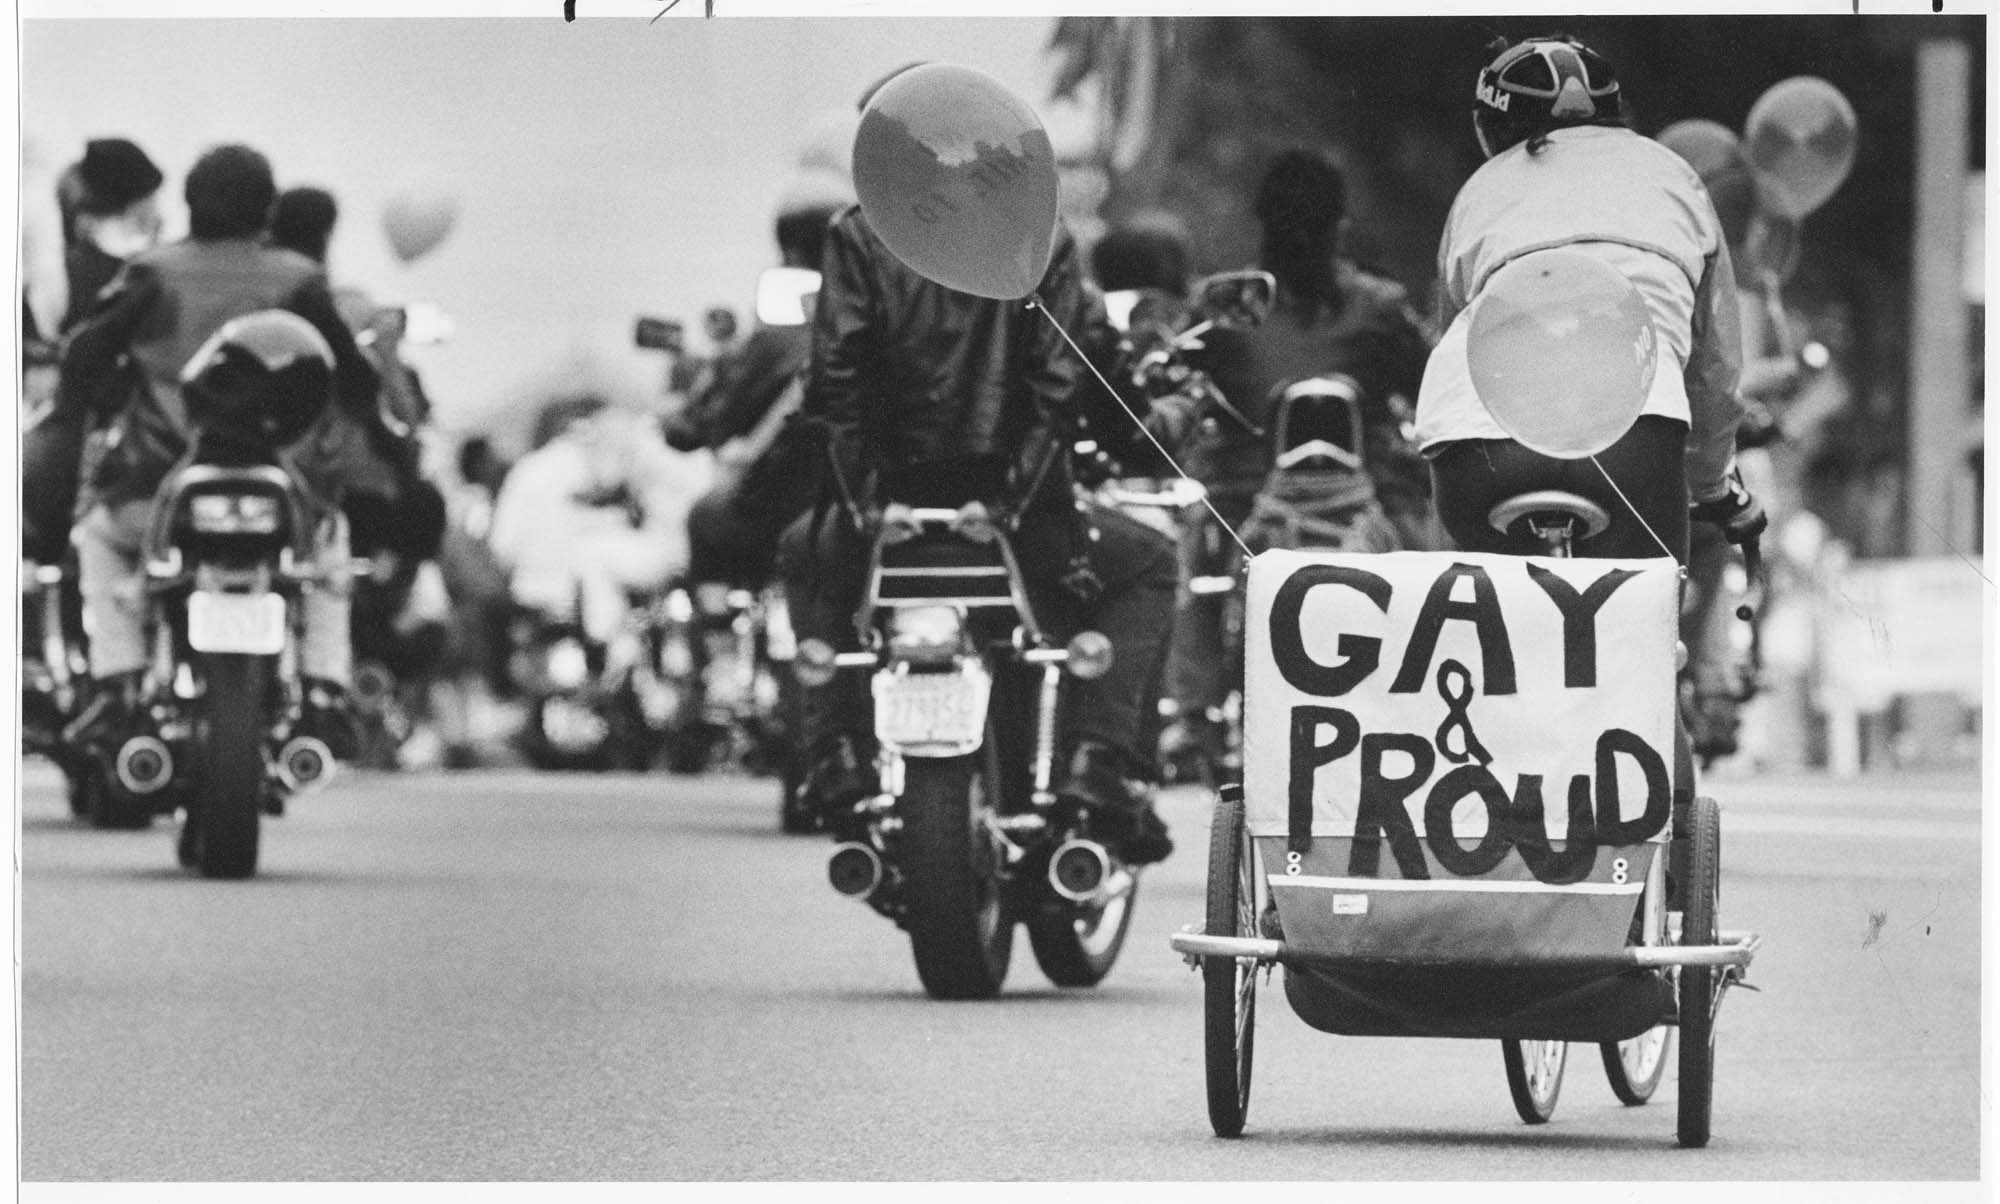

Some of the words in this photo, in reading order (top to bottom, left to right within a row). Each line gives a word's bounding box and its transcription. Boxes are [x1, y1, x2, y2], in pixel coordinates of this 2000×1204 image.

[1269, 562, 1647, 697] GAY
[1435, 658, 1494, 767] &
[1288, 705, 1672, 885] PROUD
